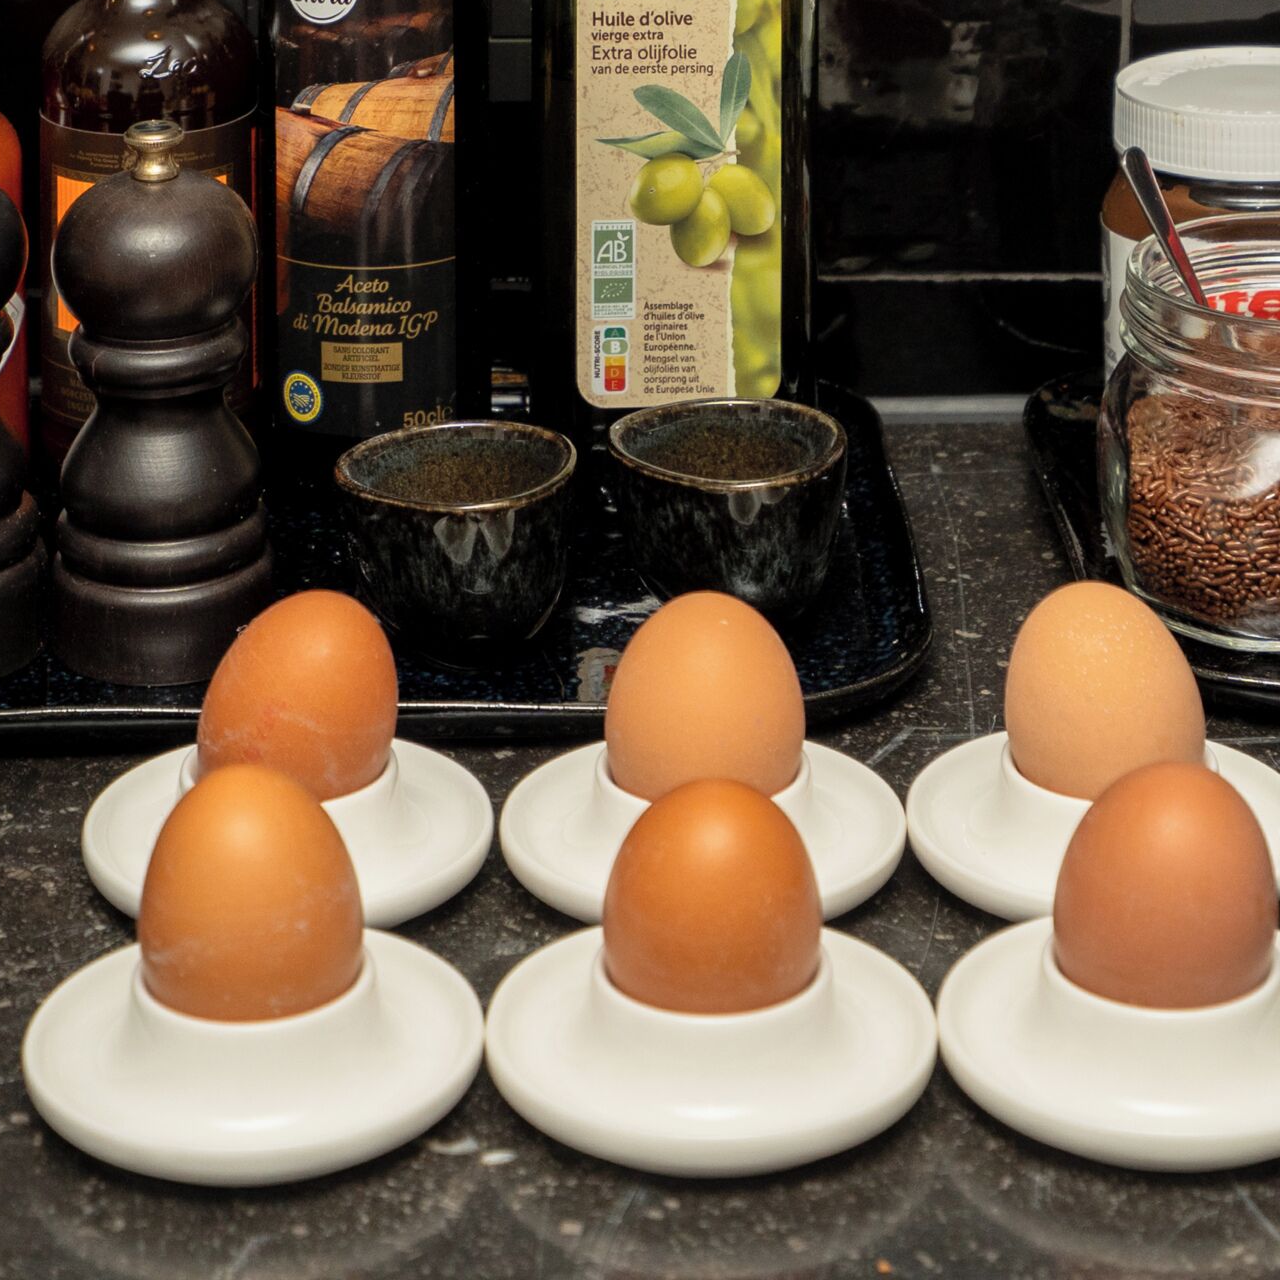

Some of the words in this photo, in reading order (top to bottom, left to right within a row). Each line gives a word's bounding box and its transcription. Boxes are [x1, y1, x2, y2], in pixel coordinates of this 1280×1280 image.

[592, 11, 635, 26] Huile
[639, 11, 693, 26] d'olive
[591, 29, 630, 43] vierge
[632, 30, 664, 40] extra
[592, 45, 632, 60] Extra
[638, 44, 697, 63] olijfolie
[591, 65, 611, 74] van
[614, 63, 629, 74] de
[632, 64, 668, 74] eerste
[671, 62, 714, 76] persing
[596, 239, 628, 263] AB
[334, 274, 390, 294] Aceto
[317, 293, 412, 315] Balsamico
[643, 301, 694, 311] Assemblage
[643, 312, 676, 321] d'huiles
[677, 311, 705, 320] d'olive
[293, 313, 308, 331] di
[312, 313, 396, 336] Modena
[398, 311, 439, 339] IGP
[643, 322, 688, 332] originaires
[643, 332, 654, 341] de
[610, 340, 621, 354] B
[593, 330, 601, 379] NUTRI-SCORE
[643, 354, 678, 364] Mengsel
[643, 375, 687, 384] oorsprong
[643, 385, 654, 394] de
[656, 385, 694, 395] Europese
